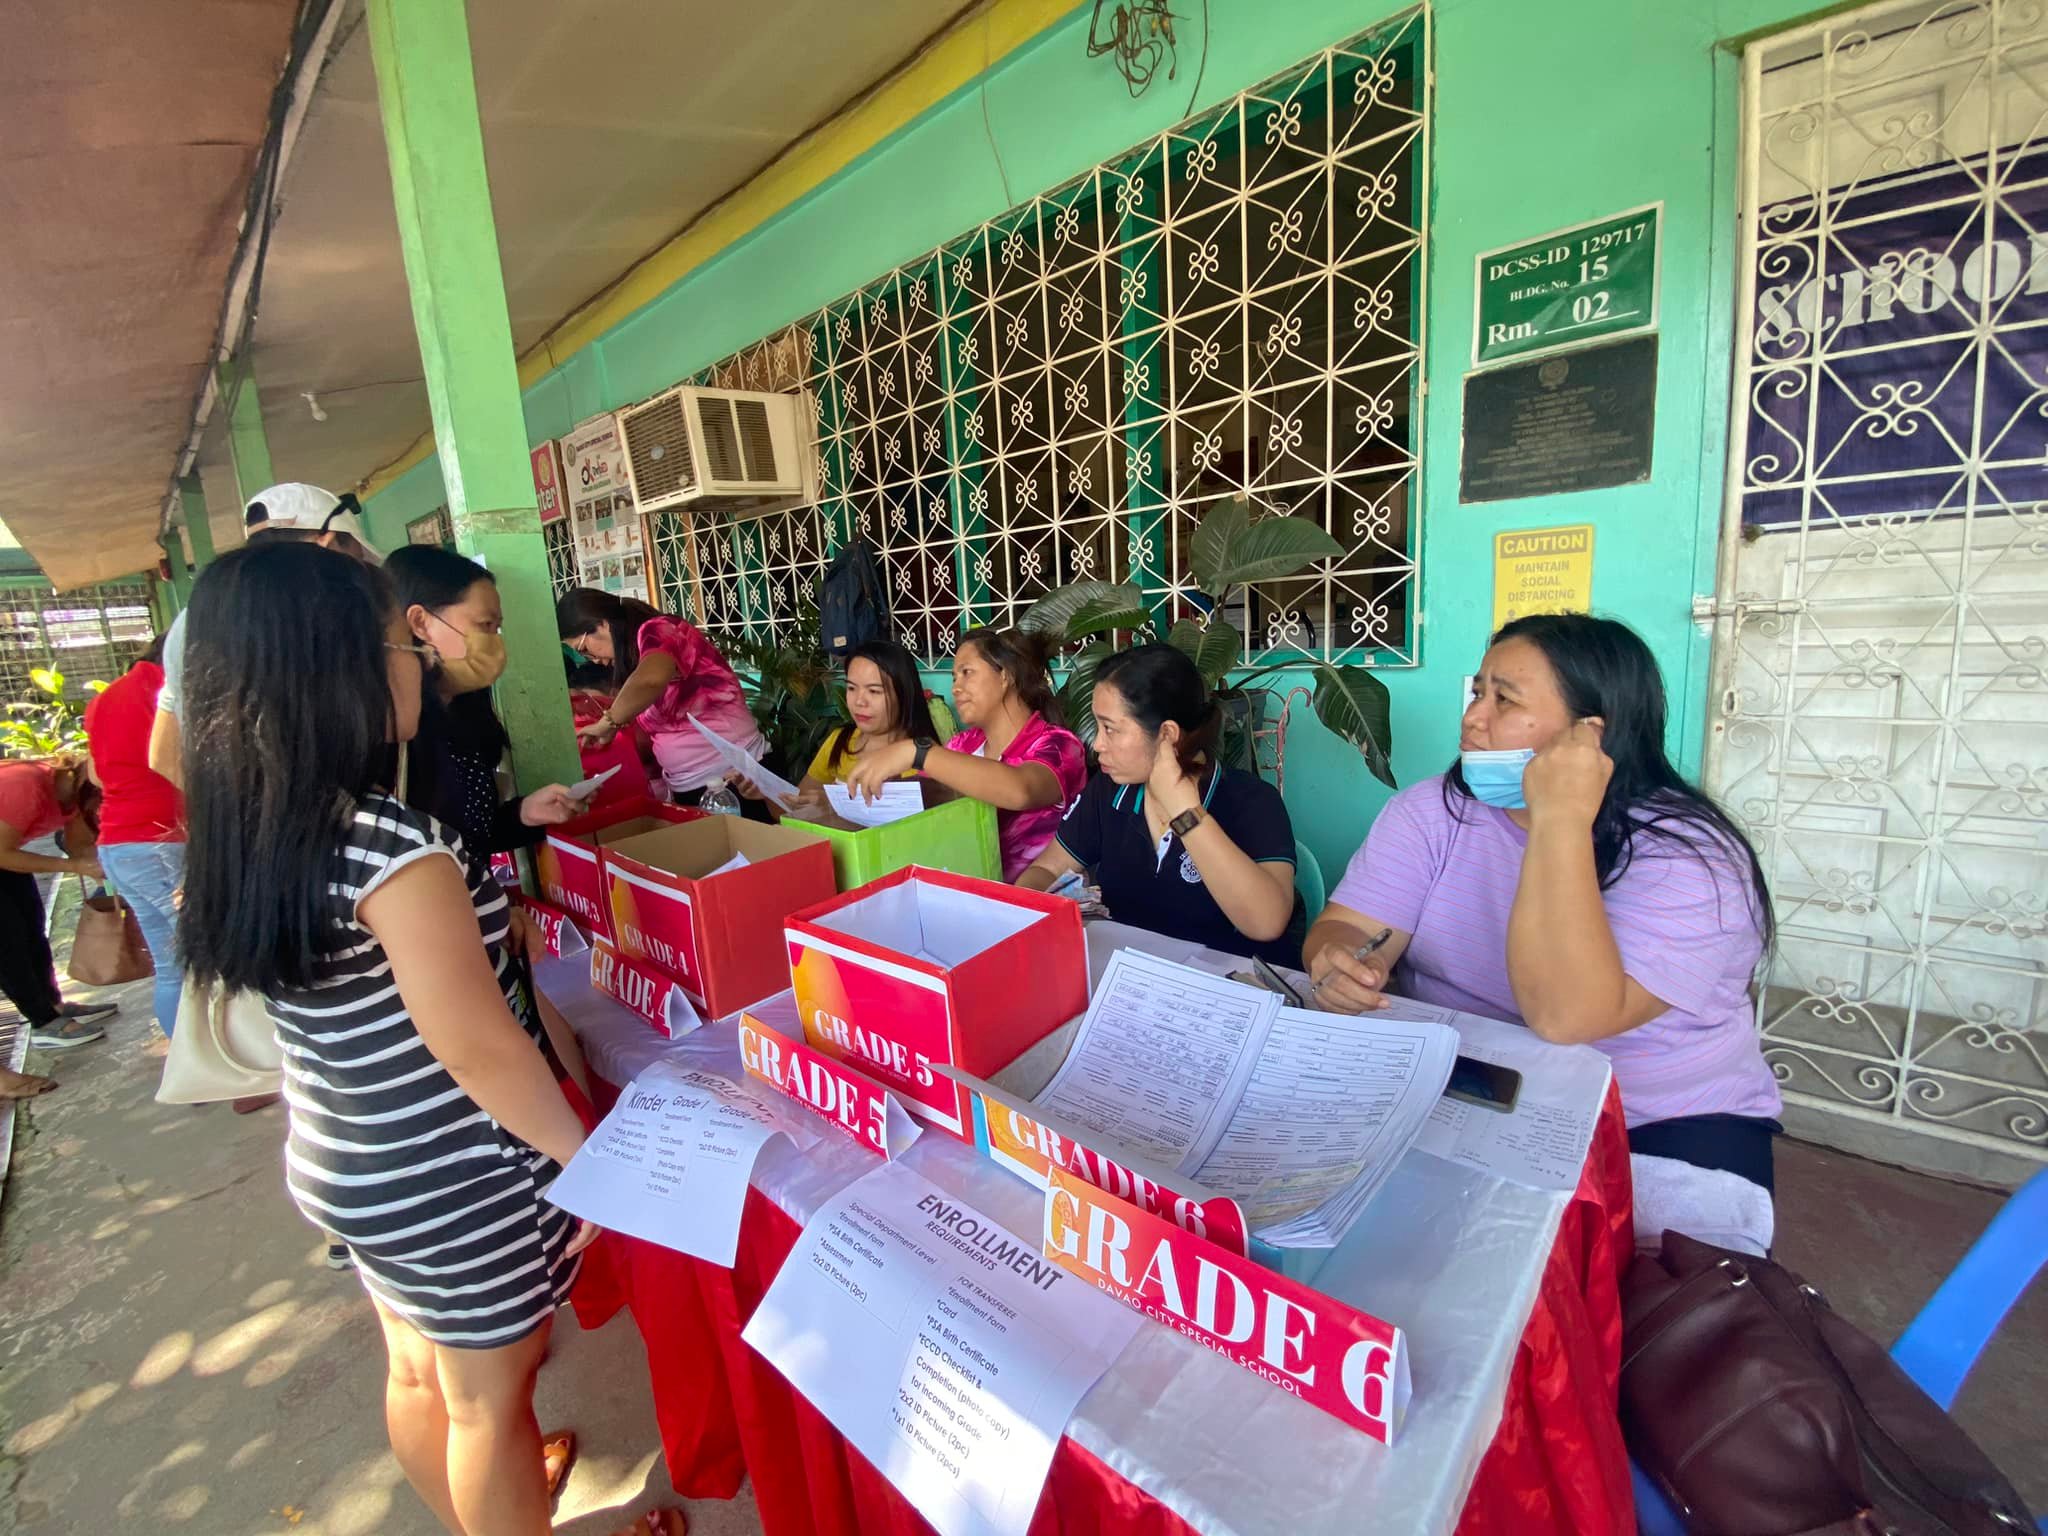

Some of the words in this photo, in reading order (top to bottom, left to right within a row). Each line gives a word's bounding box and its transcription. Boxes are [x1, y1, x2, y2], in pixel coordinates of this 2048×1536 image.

[1489, 246, 1570, 281] DCSS-ID
[1580, 223, 1646, 255] 129717
[1510, 284, 1548, 301] BLDG.
[1551, 280, 1570, 290] No.
[1578, 256, 1609, 284] 15
[1488, 322, 1539, 345] Rm.
[1572, 291, 1609, 323] 02
[1504, 534, 1584, 554] CAUTION
[1515, 560, 1570, 574] MAINTAIN
[1508, 588, 1575, 602] DISTANCING
[1521, 576, 1560, 588] SOCIAL
[549, 883, 592, 919] GRADE
[591, 902, 600, 922] 3
[552, 920, 561, 951] 3
[625, 923, 677, 970] GRADE
[679, 951, 689, 976] 4
[591, 946, 656, 1020] GRADE
[815, 1009, 911, 1078] GRADE
[915, 1052, 934, 1087] 5
[627, 1091, 667, 1112] Kinder
[740, 1026, 860, 1134] GRADE
[868, 1096, 887, 1149] 5
[1009, 1110, 1163, 1219] GRADE
[1175, 1198, 1207, 1240] 6
[849, 1202, 876, 1222] Special
[874, 1219, 917, 1250] Department
[915, 1247, 937, 1265] Level
[916, 1194, 1063, 1291] ENROLLMENT
[925, 1221, 998, 1271] REQUIREMENTS
[957, 1276, 974, 1289] FOR
[973, 1285, 1018, 1320] TRANSFEREE
[1045, 1186, 1316, 1388] GRADE
[1341, 1340, 1393, 1425] 6
[985, 1315, 1007, 1334] Form
[1098, 1278, 1142, 1309] DAVAO
[1146, 1306, 1174, 1328] CITY
[1180, 1323, 1234, 1361] SPECIAL
[1239, 1355, 1302, 1398] SCHOOL
[916, 1356, 957, 1396] Completion
[941, 1351, 976, 1385] Checklist
[942, 1327, 959, 1346] Birth
[959, 1341, 999, 1376] Certificate
[911, 1375, 921, 1390] for
[957, 1414, 982, 1440] Grade
[913, 1401, 922, 1415] ID
[922, 1407, 948, 1437] Picture
[948, 1432, 970, 1459] (2pc)
[906, 1422, 914, 1434] ID
[914, 1429, 937, 1455] Picture
